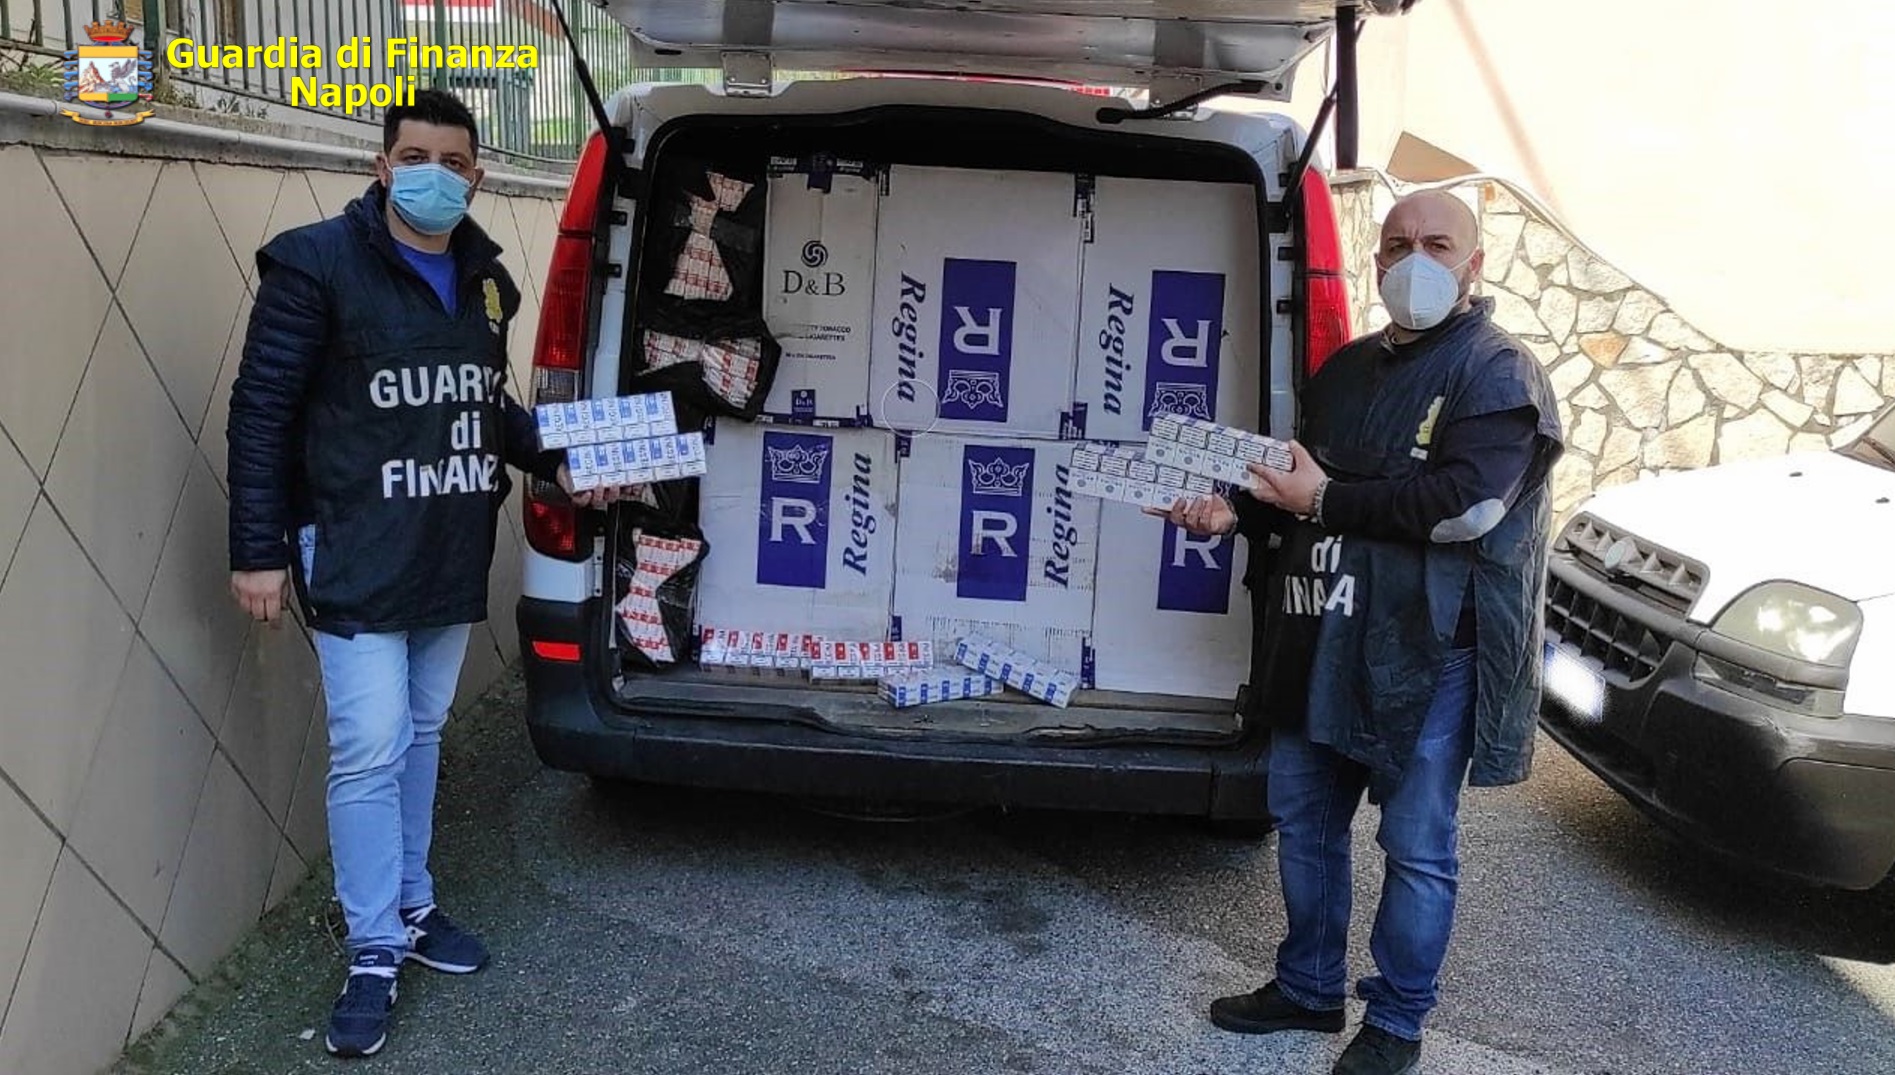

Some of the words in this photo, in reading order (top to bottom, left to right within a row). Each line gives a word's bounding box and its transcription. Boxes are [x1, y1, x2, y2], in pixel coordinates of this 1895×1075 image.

[783, 266, 846, 296] D&B
[891, 271, 927, 403] Regina
[953, 306, 1002, 355] R
[1098, 282, 1135, 417] Regina
[1161, 318, 1210, 368] R
[369, 363, 506, 409] GUARD
[451, 411, 482, 451] di
[381, 453, 499, 499] FINANZ
[770, 496, 817, 545] R
[842, 452, 874, 576] Regina
[969, 510, 1018, 558] R
[1044, 463, 1080, 589] Regina
[1172, 527, 1221, 570] R
[1312, 534, 1344, 572] di
